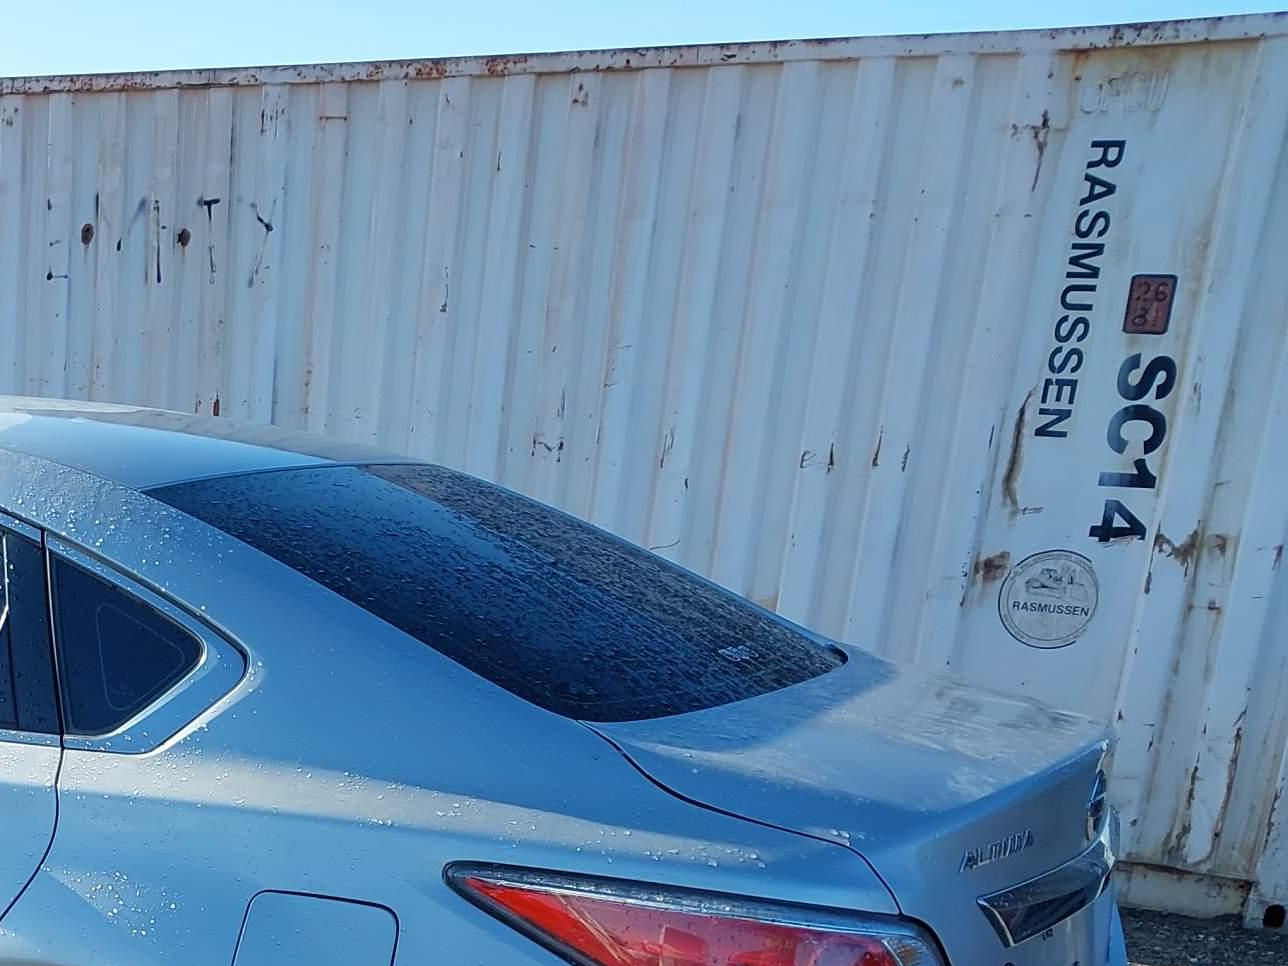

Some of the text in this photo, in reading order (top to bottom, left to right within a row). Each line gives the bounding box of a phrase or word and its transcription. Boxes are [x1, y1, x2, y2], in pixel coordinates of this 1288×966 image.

[1035, 139, 1126, 438] RASMUSSEN
[1089, 352, 1177, 543] SC14
[1012, 601, 1090, 616] RASMUSSEN
[958, 828, 1034, 873] ALTIMA
